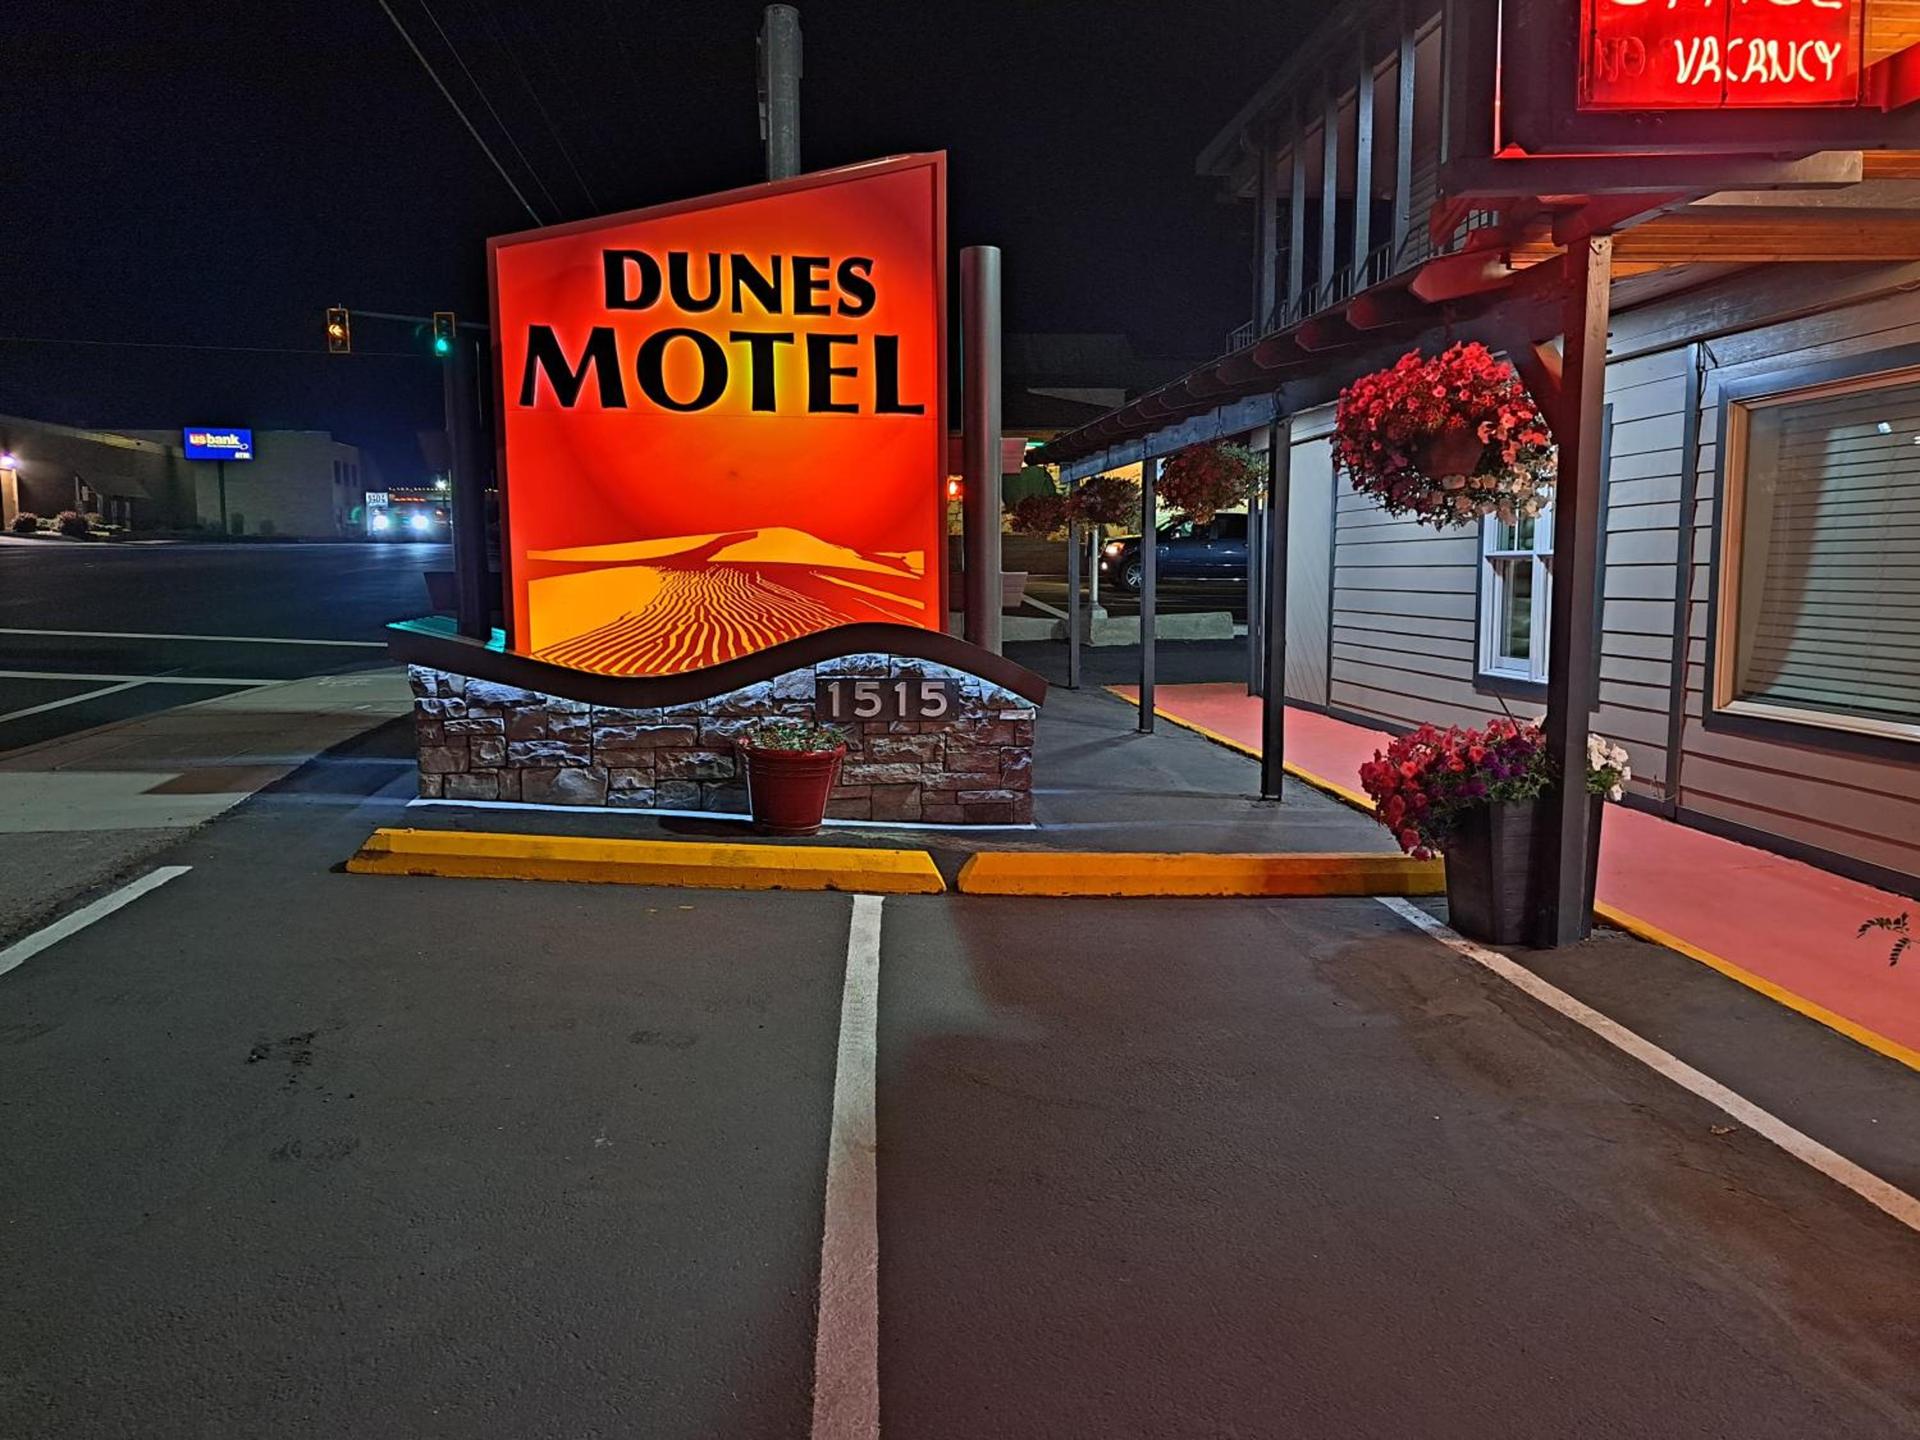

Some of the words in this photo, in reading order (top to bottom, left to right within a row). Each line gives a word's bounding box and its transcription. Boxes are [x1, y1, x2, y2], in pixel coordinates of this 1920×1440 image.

[1595, 36, 1646, 82] NO
[1674, 35, 1842, 85] VACANCY
[603, 249, 877, 318] DUNES
[519, 324, 925, 415] MOTEL
[827, 681, 948, 718] 1515
